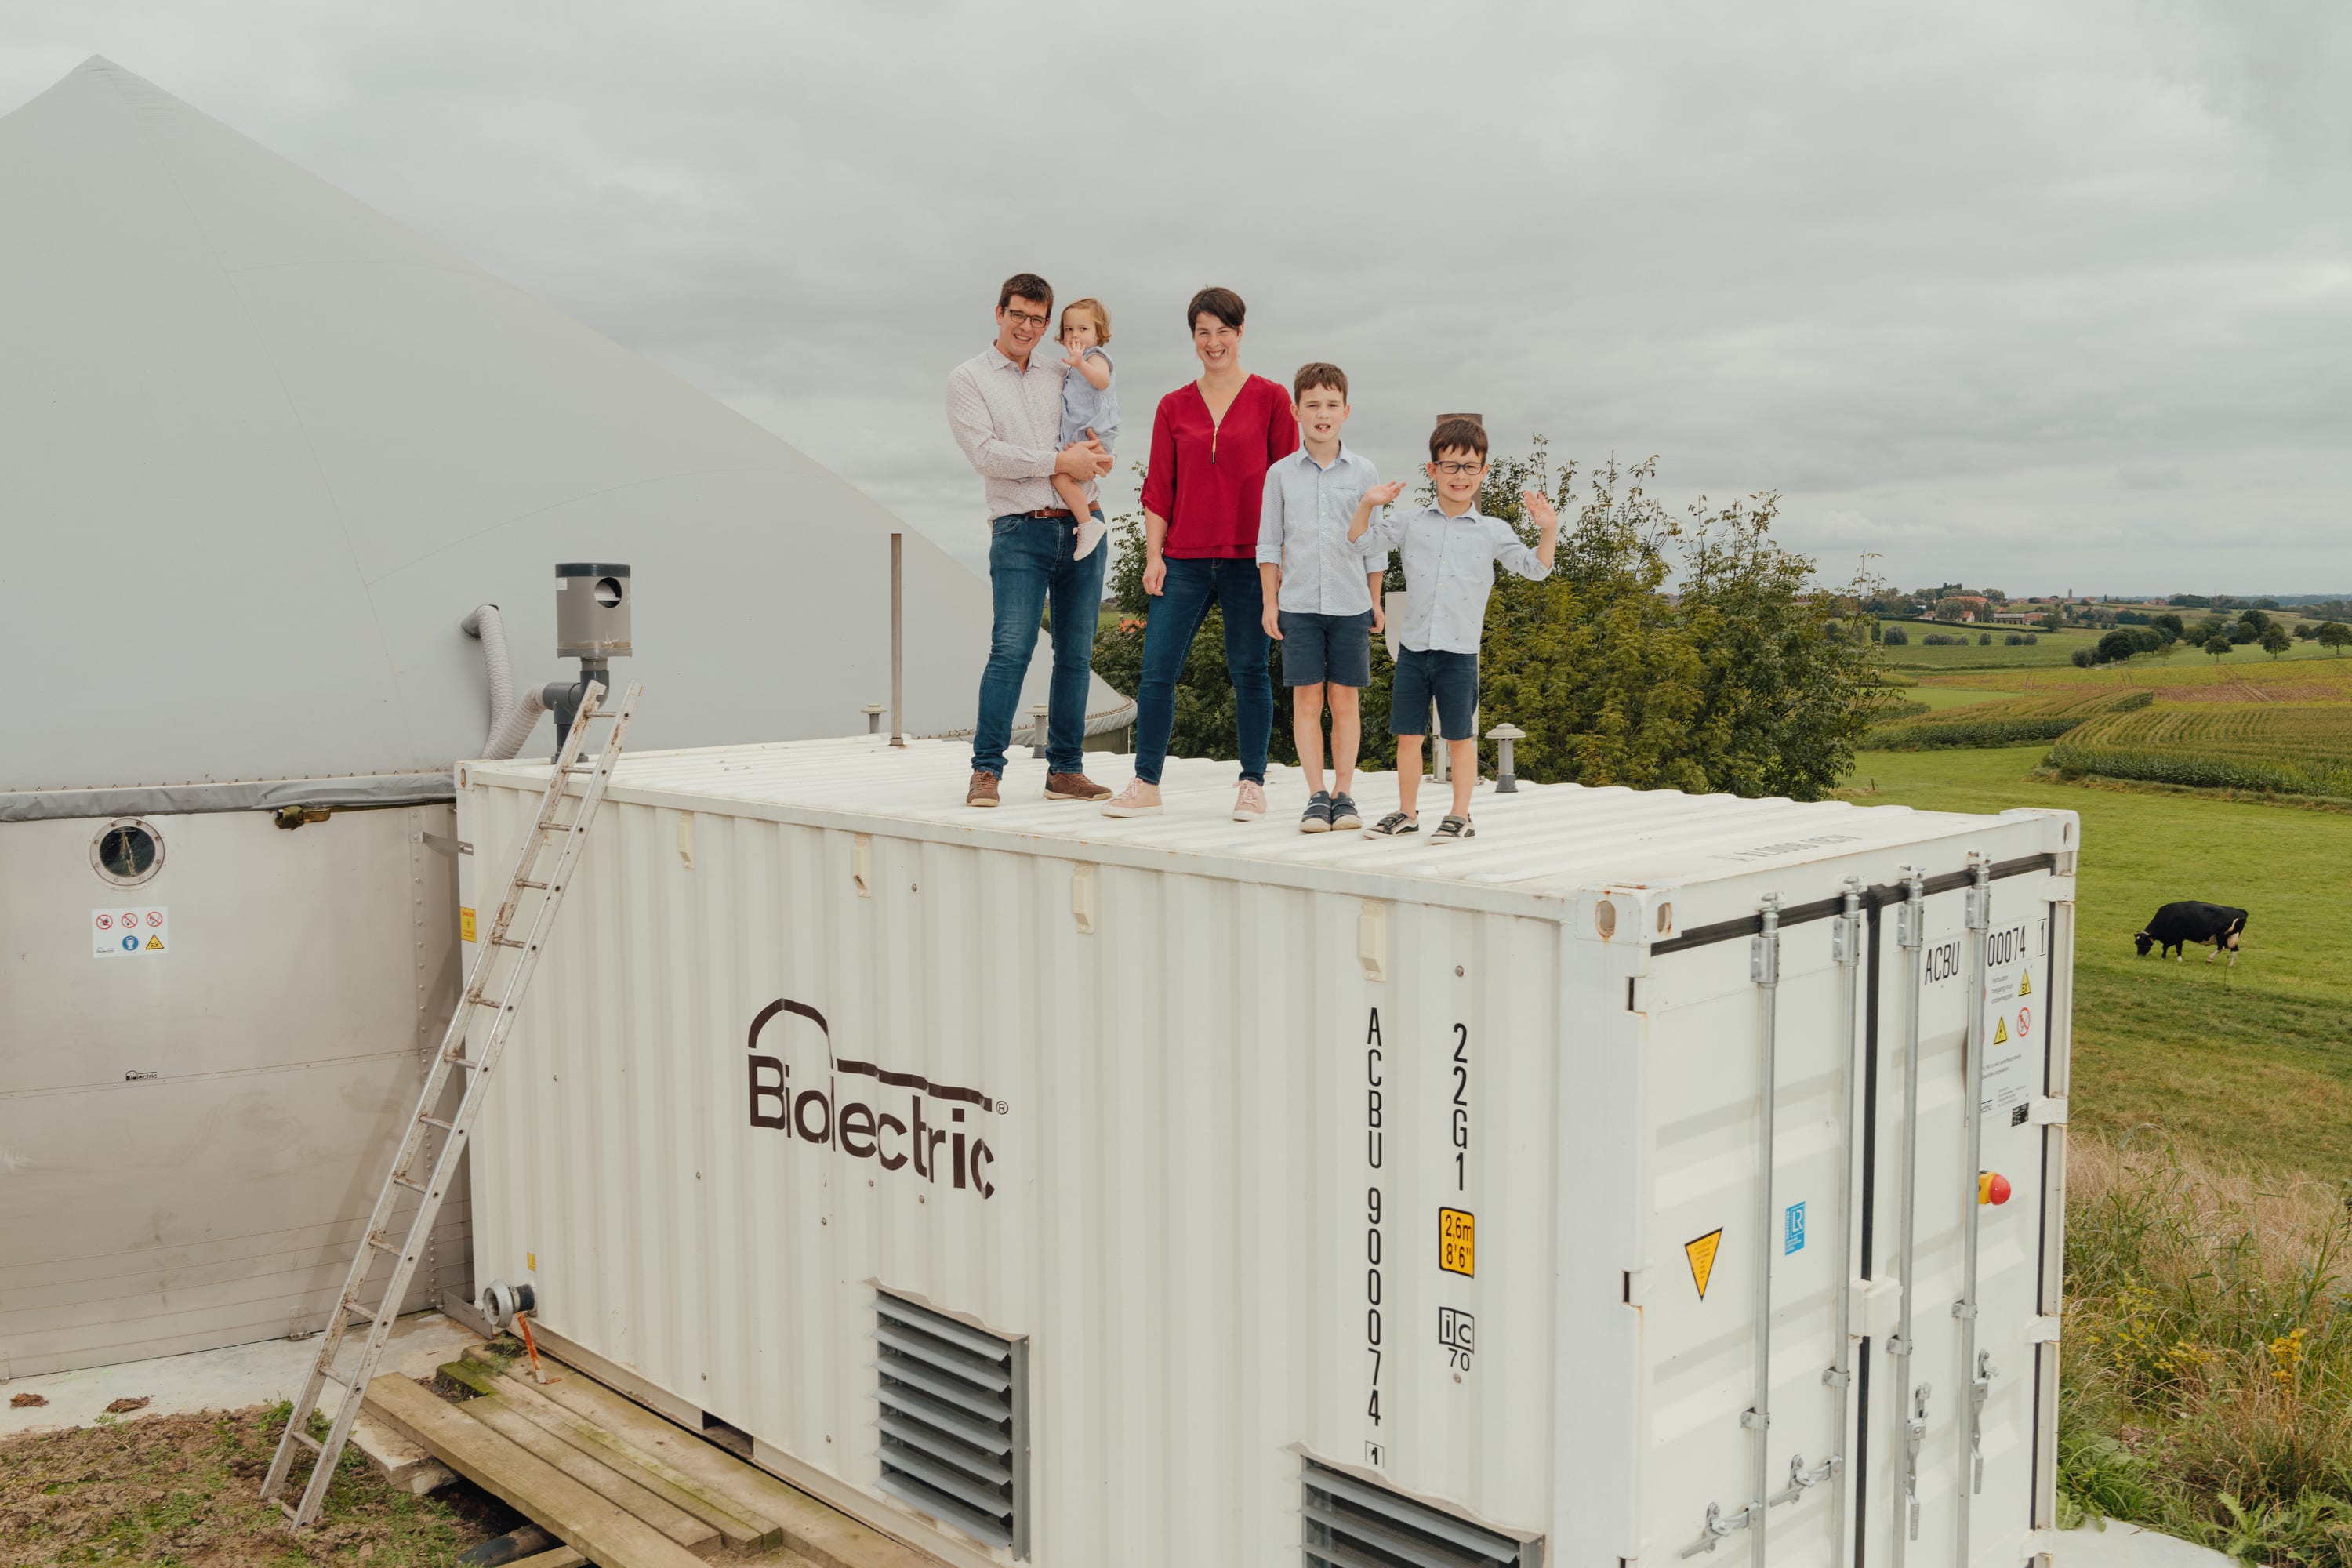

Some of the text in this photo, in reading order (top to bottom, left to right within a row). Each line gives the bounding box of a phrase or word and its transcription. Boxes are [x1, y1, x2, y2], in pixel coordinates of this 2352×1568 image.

[1925, 941, 1961, 985] ACBU
[1987, 925, 2027, 967] 00074
[1367, 1007, 1382, 1169] ACBU
[1452, 1023, 1468, 1191] 22G1
[1792, 1209, 1803, 1232] LR
[1367, 1187, 1381, 1426] 900074
[1447, 1348, 1470, 1372] 70
